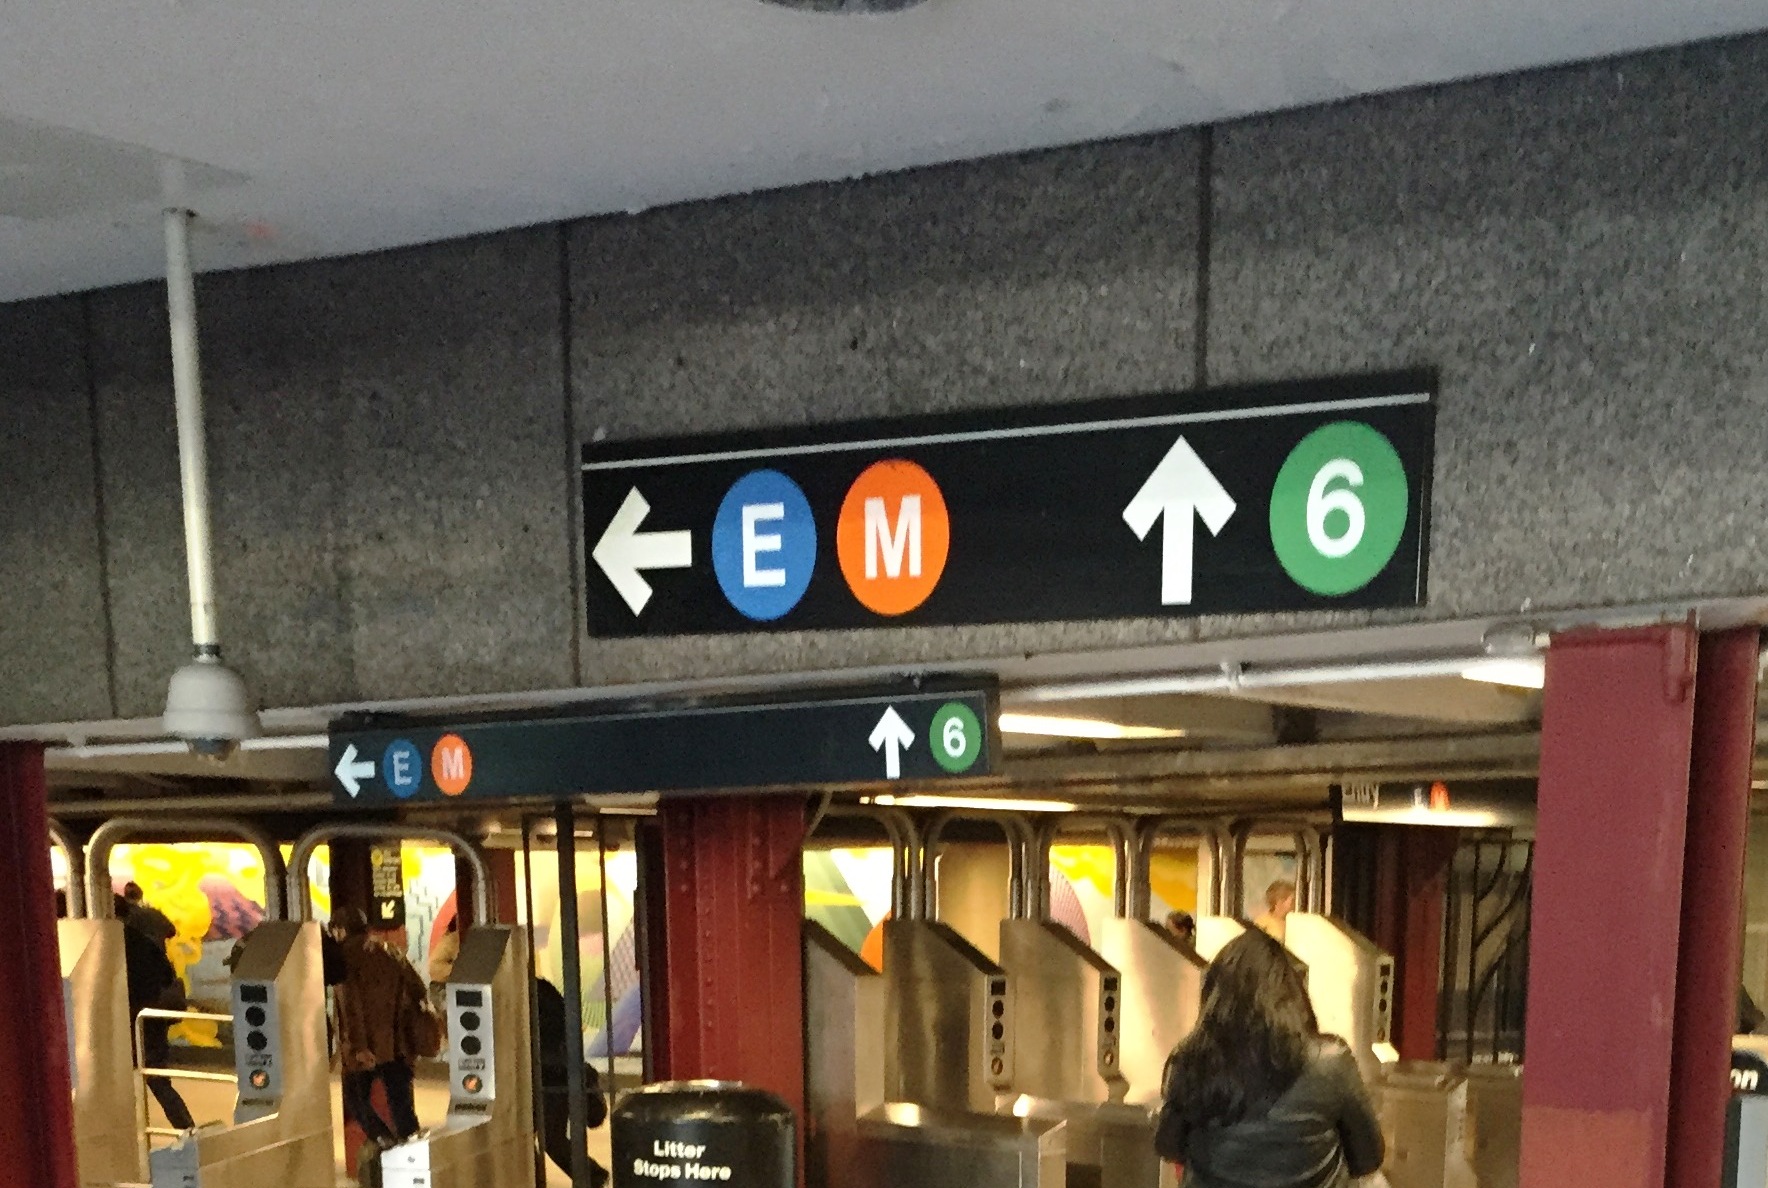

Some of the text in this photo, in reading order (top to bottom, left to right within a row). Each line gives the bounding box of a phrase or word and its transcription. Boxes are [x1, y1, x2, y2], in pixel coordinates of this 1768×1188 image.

[1305, 457, 1366, 559] 6
[740, 495, 922, 588] E M
[943, 716, 966, 759] 6
[393, 747, 464, 785] E M
[653, 1139, 706, 1159] Litter
[633, 1158, 732, 1181] Stops Here
